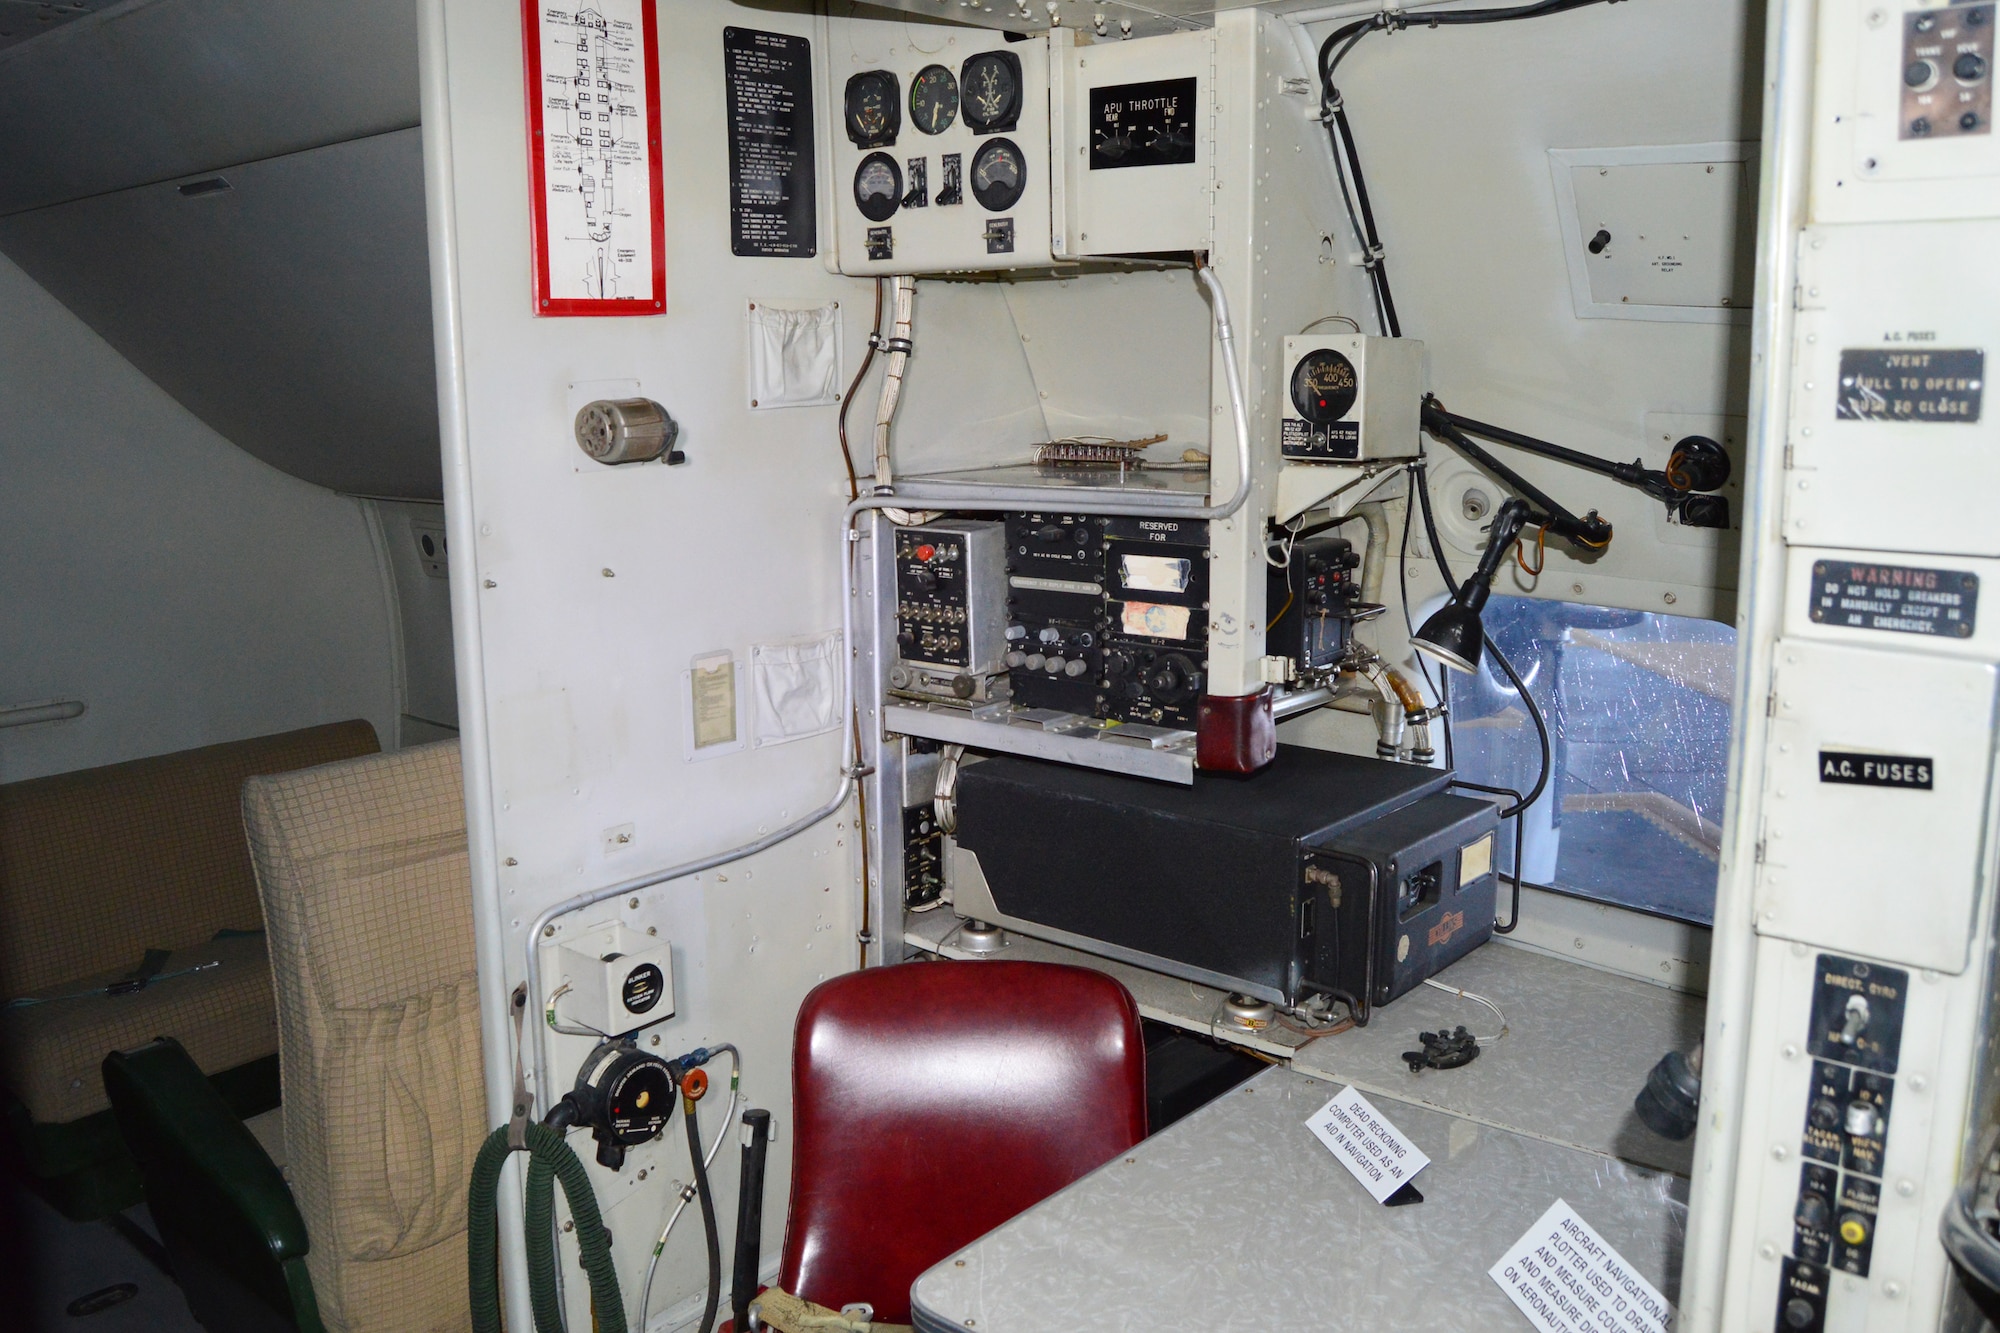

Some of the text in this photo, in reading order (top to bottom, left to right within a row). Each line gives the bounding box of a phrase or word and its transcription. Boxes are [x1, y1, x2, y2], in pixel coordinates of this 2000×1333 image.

[1104, 97, 1178, 114] APU THROTTLE
[1106, 113, 1118, 122] REAR
[1891, 354, 1930, 367] VENT
[1324, 374, 1338, 383] 400
[1338, 378, 1353, 387] 450
[1901, 377, 1919, 390] TO
[1926, 378, 1966, 391] OPEN
[1919, 401, 1968, 414] CLOSE
[1140, 521, 1178, 532] RESERVED
[1150, 533, 1166, 541] FOR
[1851, 568, 1938, 588] WARNING
[1825, 583, 1962, 605] DO NOT HOLD BREAKERS
[1821, 597, 1961, 620] IN MANUALLY EXCEPT IN
[1848, 614, 1936, 633] AN EMERGENCY.
[1824, 760, 1930, 782] A.C. FUSES
[628, 971, 651, 984] BLINKER
[1869, 982, 1897, 999] GYRO
[1349, 1102, 1407, 1158] DEAD RECKONING
[1329, 1104, 1404, 1179] COMPUTER USED AS AN
[1324, 1122, 1384, 1182] AID IN NAVIGATION
[1503, 1266, 1520, 1284] ON
[1535, 1246, 1557, 1268] AND
[1554, 1265, 1600, 1313] MEASURE
[1549, 1232, 1588, 1273] PLOTTER
[1585, 1269, 1613, 1298] USED
[1611, 1295, 1627, 1312] TO
[1560, 1218, 1674, 1331] AIRCRAFT NAVIGATIONAL
[1519, 1256, 1541, 1278] AND
[1538, 1276, 1582, 1323] MEASURE
